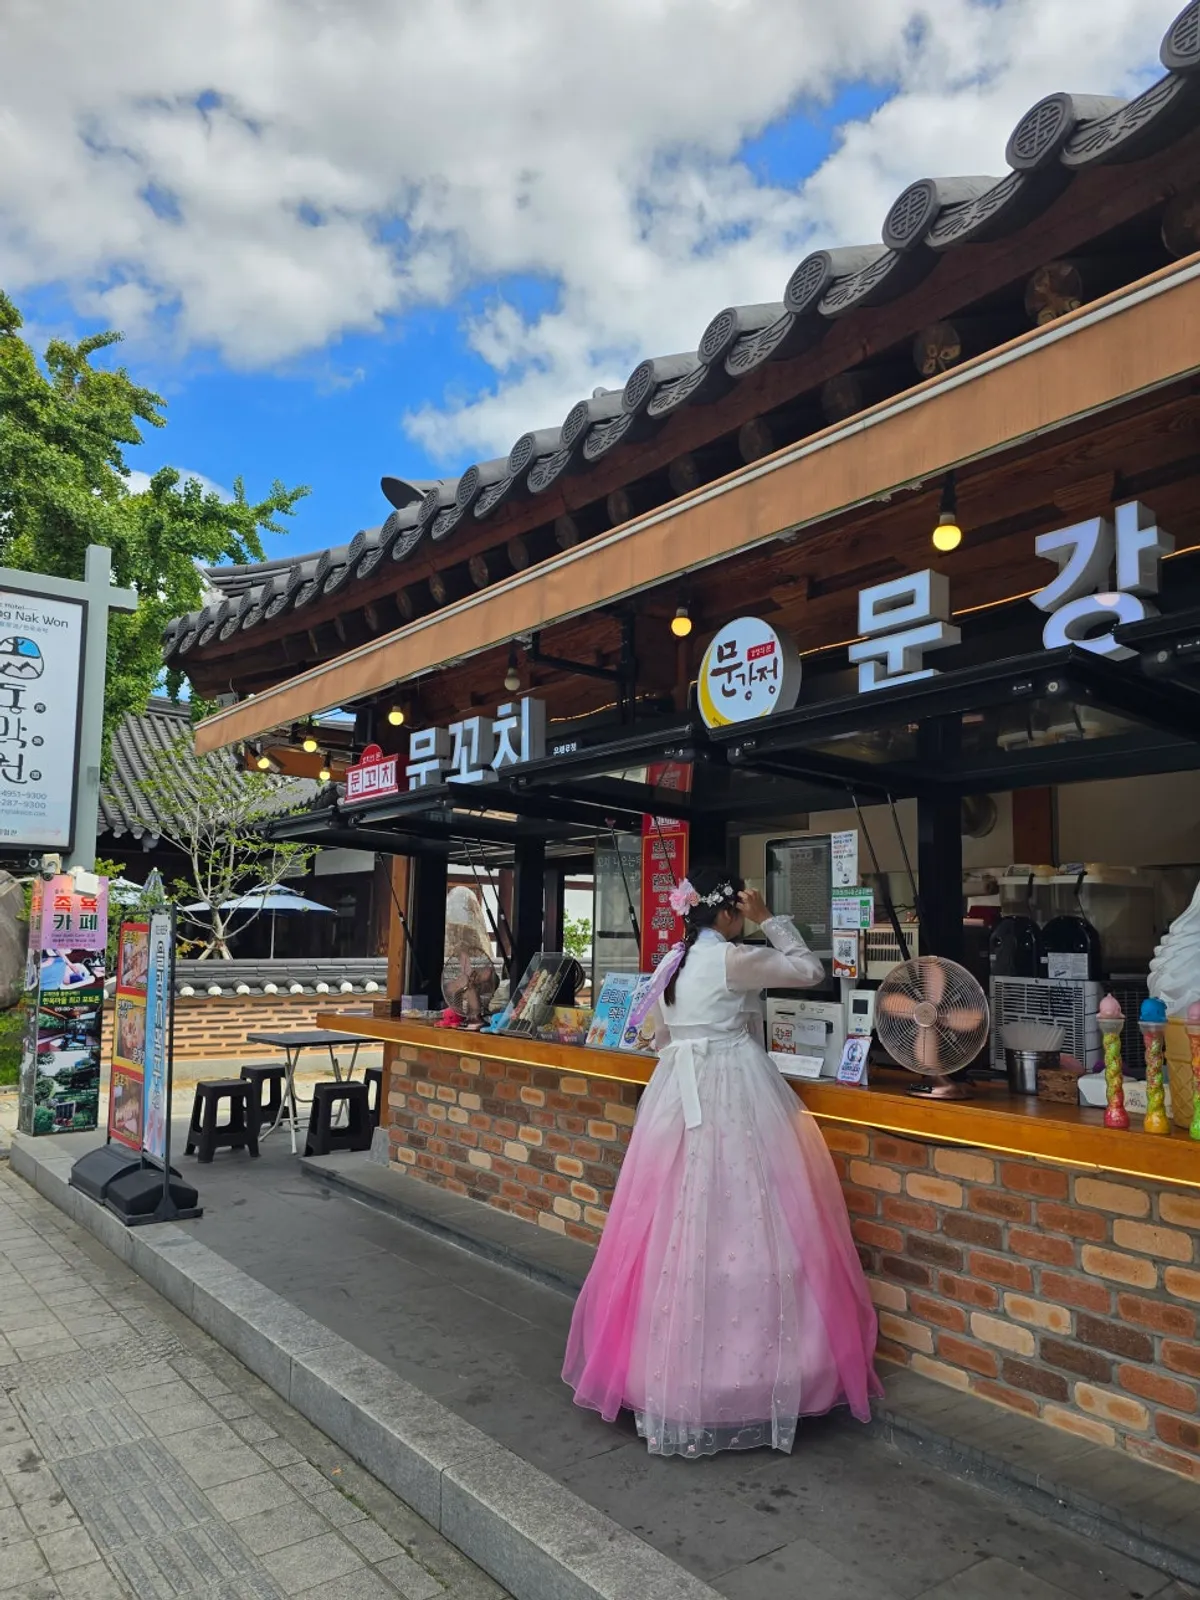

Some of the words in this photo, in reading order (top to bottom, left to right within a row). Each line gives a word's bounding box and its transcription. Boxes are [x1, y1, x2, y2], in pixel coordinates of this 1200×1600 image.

[16, 611, 39, 624] Nak
[43, 615, 69, 628] Won
[710, 640, 778, 700] 문강정
[351, 763, 394, 793] 문꼬치
[53, 914, 98, 930] 카페
